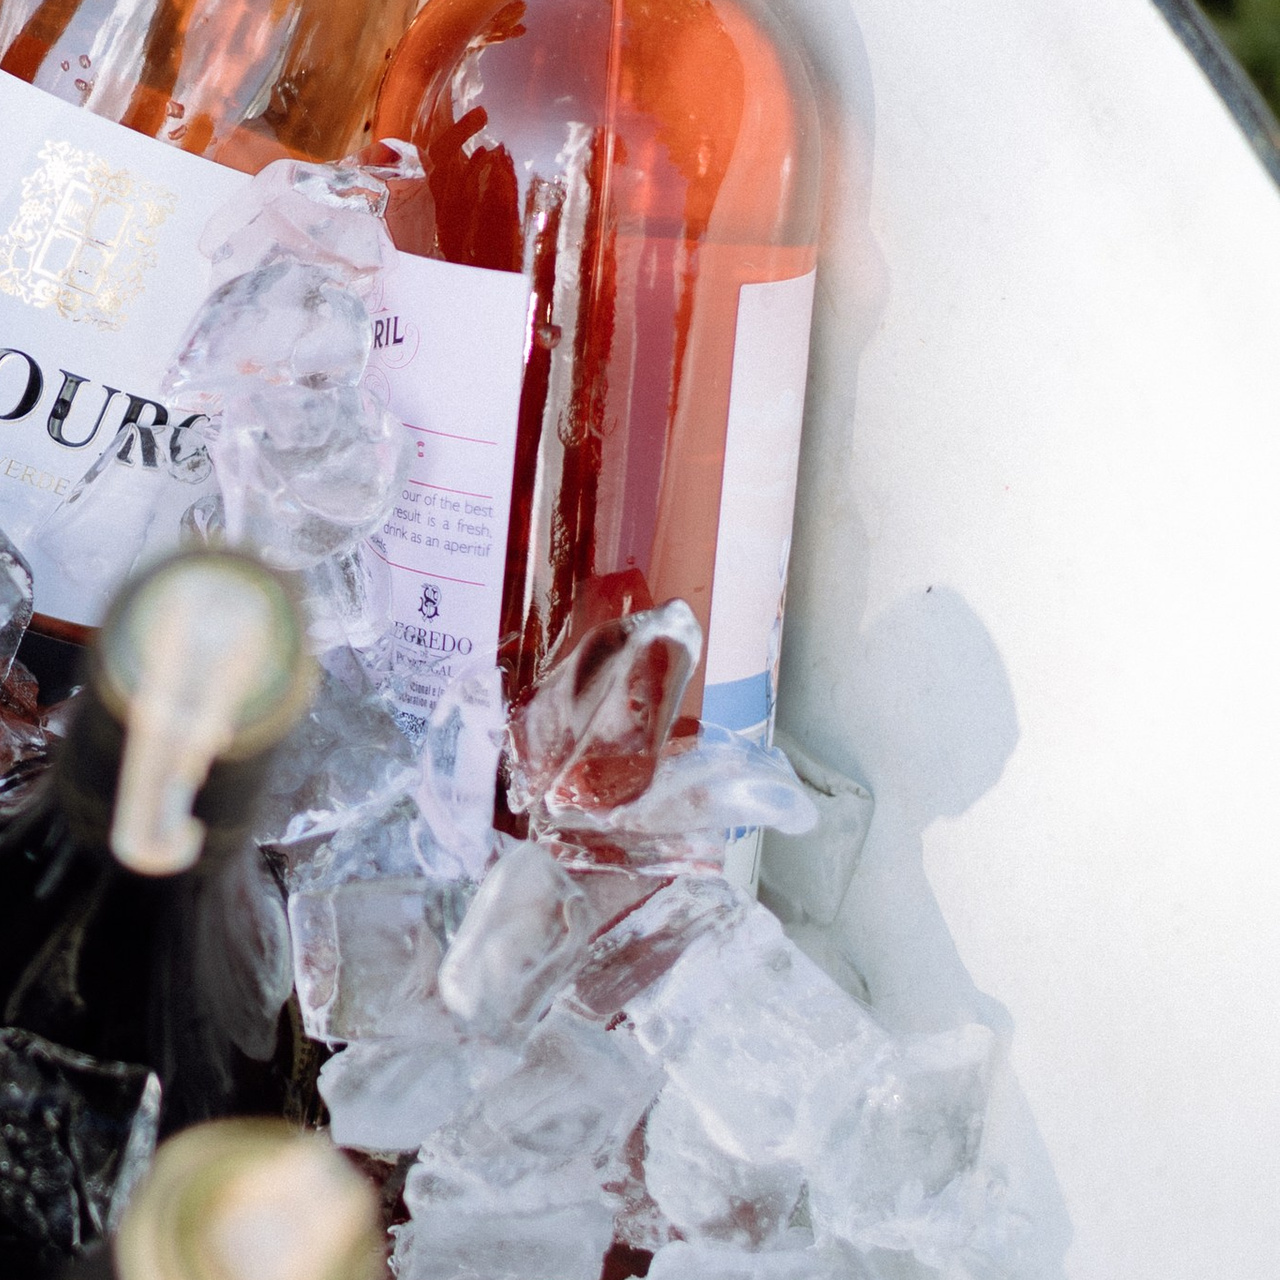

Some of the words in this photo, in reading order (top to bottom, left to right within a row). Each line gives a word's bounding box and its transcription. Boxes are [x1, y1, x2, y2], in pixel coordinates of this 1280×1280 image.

[373, 316, 405, 349] RIL
[392, 506, 422, 524] result
[427, 513, 436, 527] is
[442, 519, 450, 530] a
[424, 493, 437, 506] of
[440, 496, 460, 512] the
[465, 500, 493, 518] best
[383, 520, 408, 540] drink
[410, 532, 422, 544] as
[425, 536, 440, 548] an
[443, 539, 492, 557] aperitif
[393, 620, 473, 656] EGREDO
